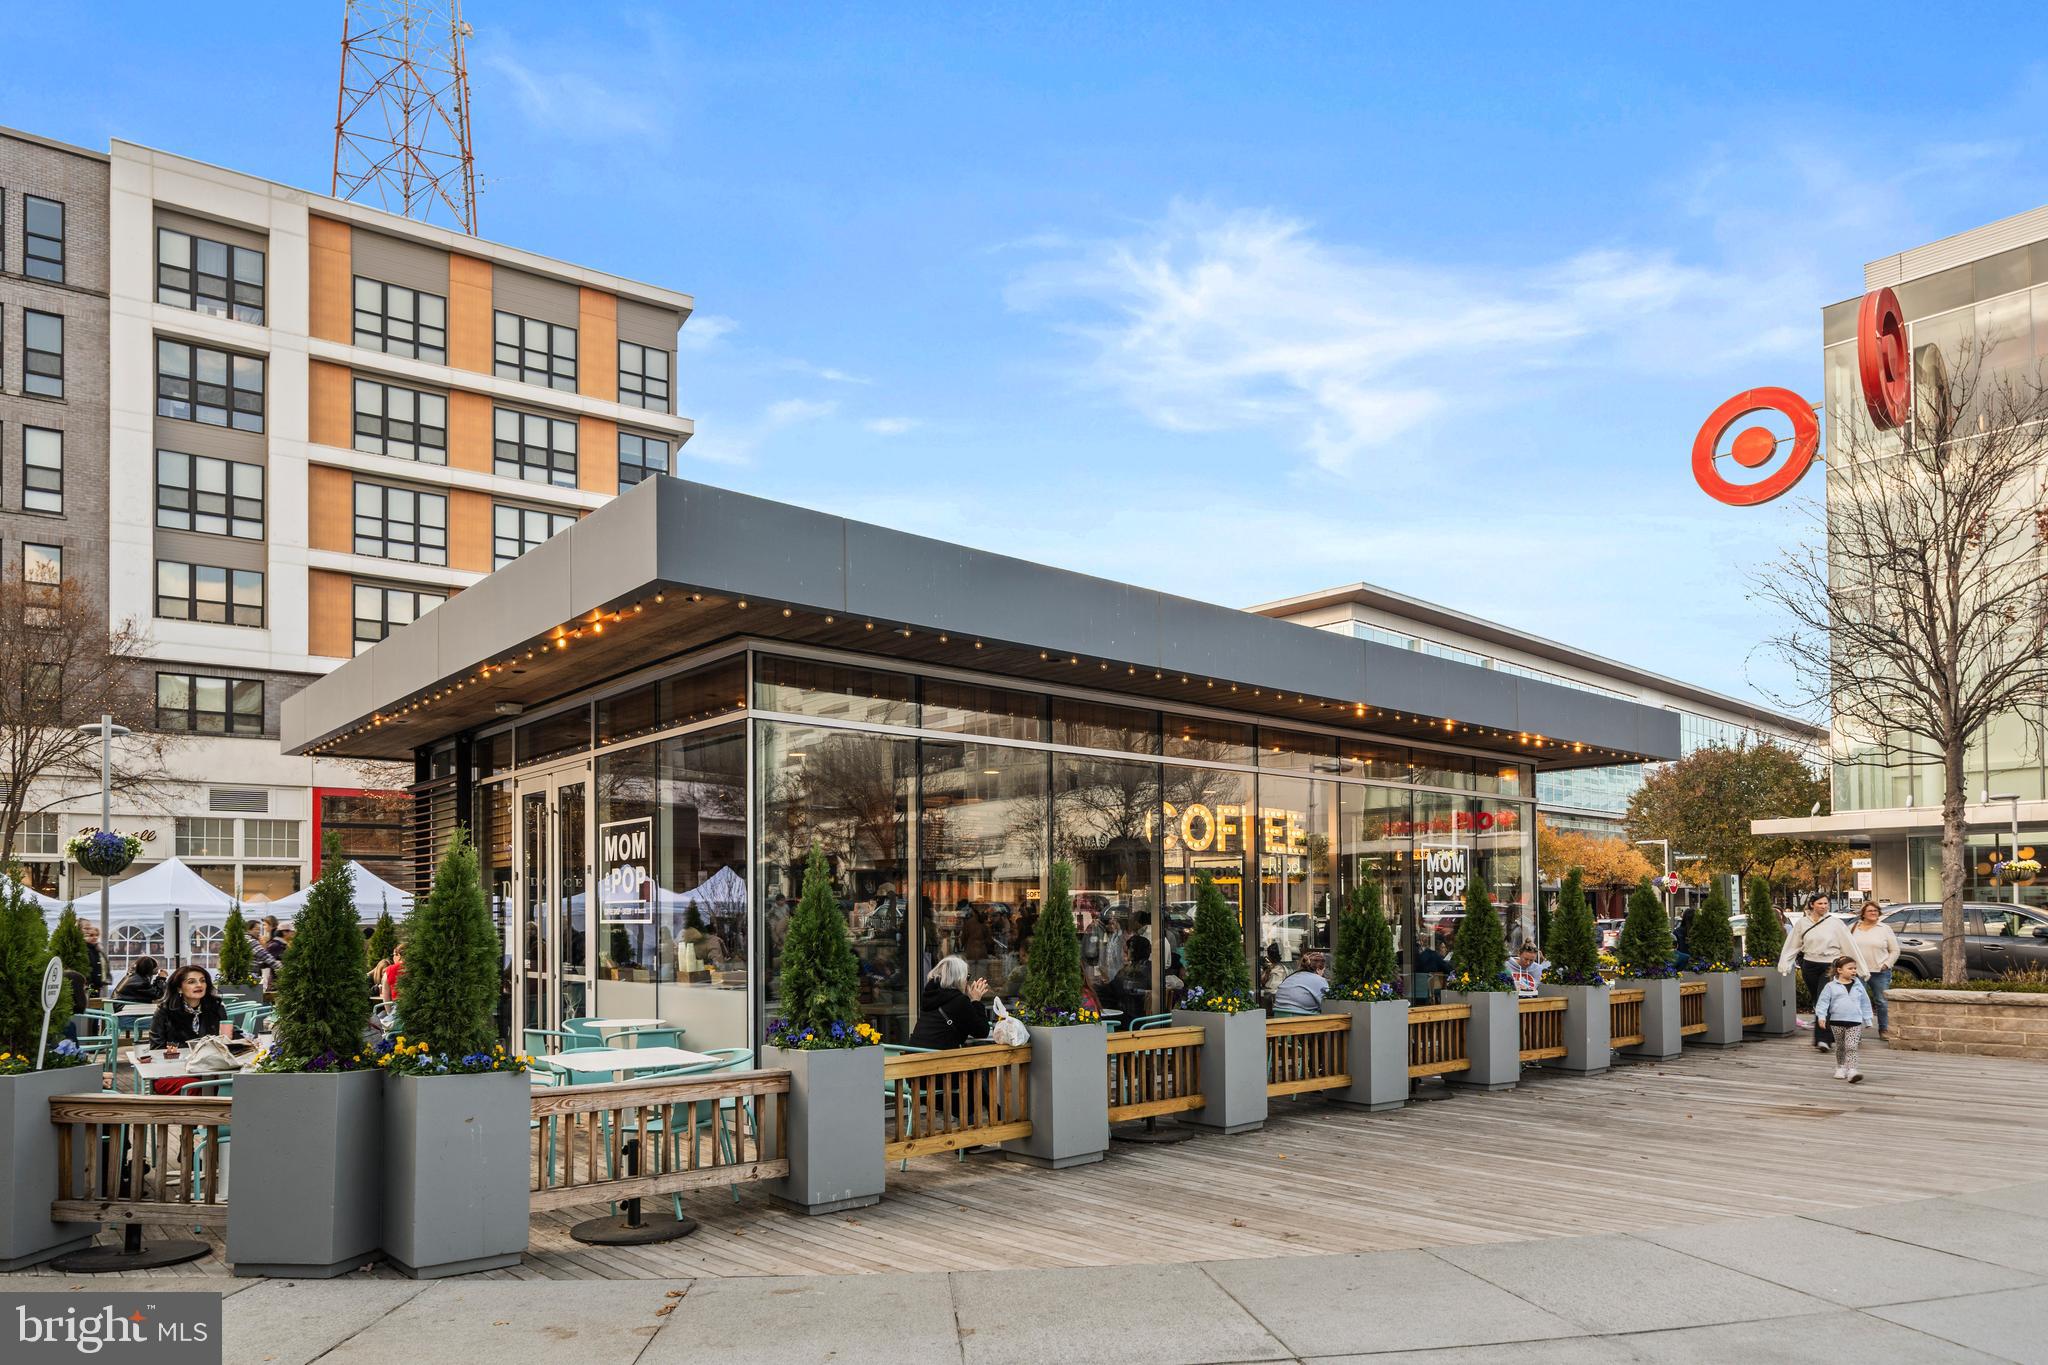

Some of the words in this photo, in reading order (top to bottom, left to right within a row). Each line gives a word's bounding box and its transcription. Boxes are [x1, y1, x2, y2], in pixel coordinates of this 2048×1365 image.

[604, 832, 646, 862] MOM
[1427, 852, 1465, 873] MOM
[612, 866, 646, 893] POP
[1434, 876, 1465, 896] POP
